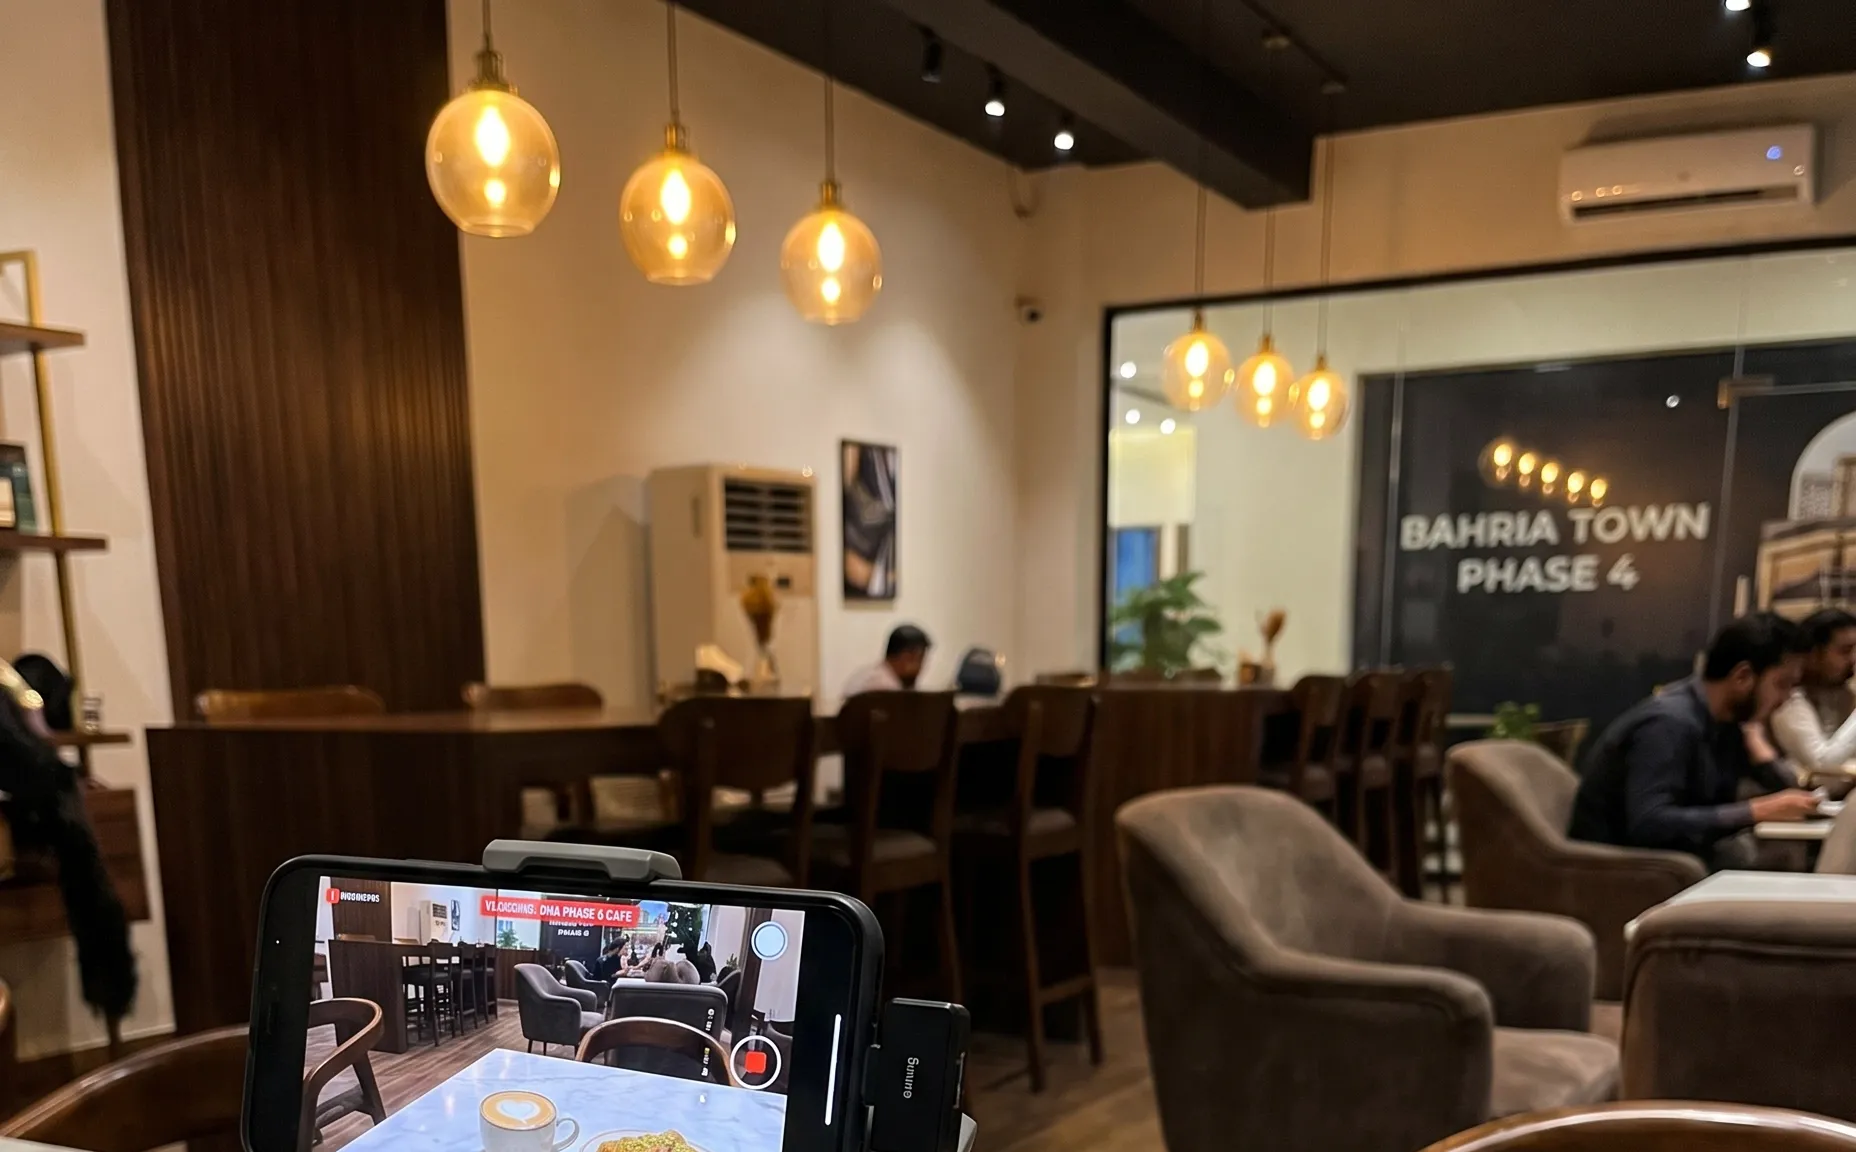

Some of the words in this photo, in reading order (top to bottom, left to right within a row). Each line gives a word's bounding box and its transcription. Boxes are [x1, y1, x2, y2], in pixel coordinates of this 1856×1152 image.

[1401, 509, 1560, 550] BAHRIA
[1567, 502, 1711, 544] TOWN
[1458, 555, 1599, 593] PHASE
[1606, 553, 1640, 591] 4
[562, 906, 595, 920] PHASE
[597, 908, 605, 921] 6
[605, 909, 633, 923] CAFE
